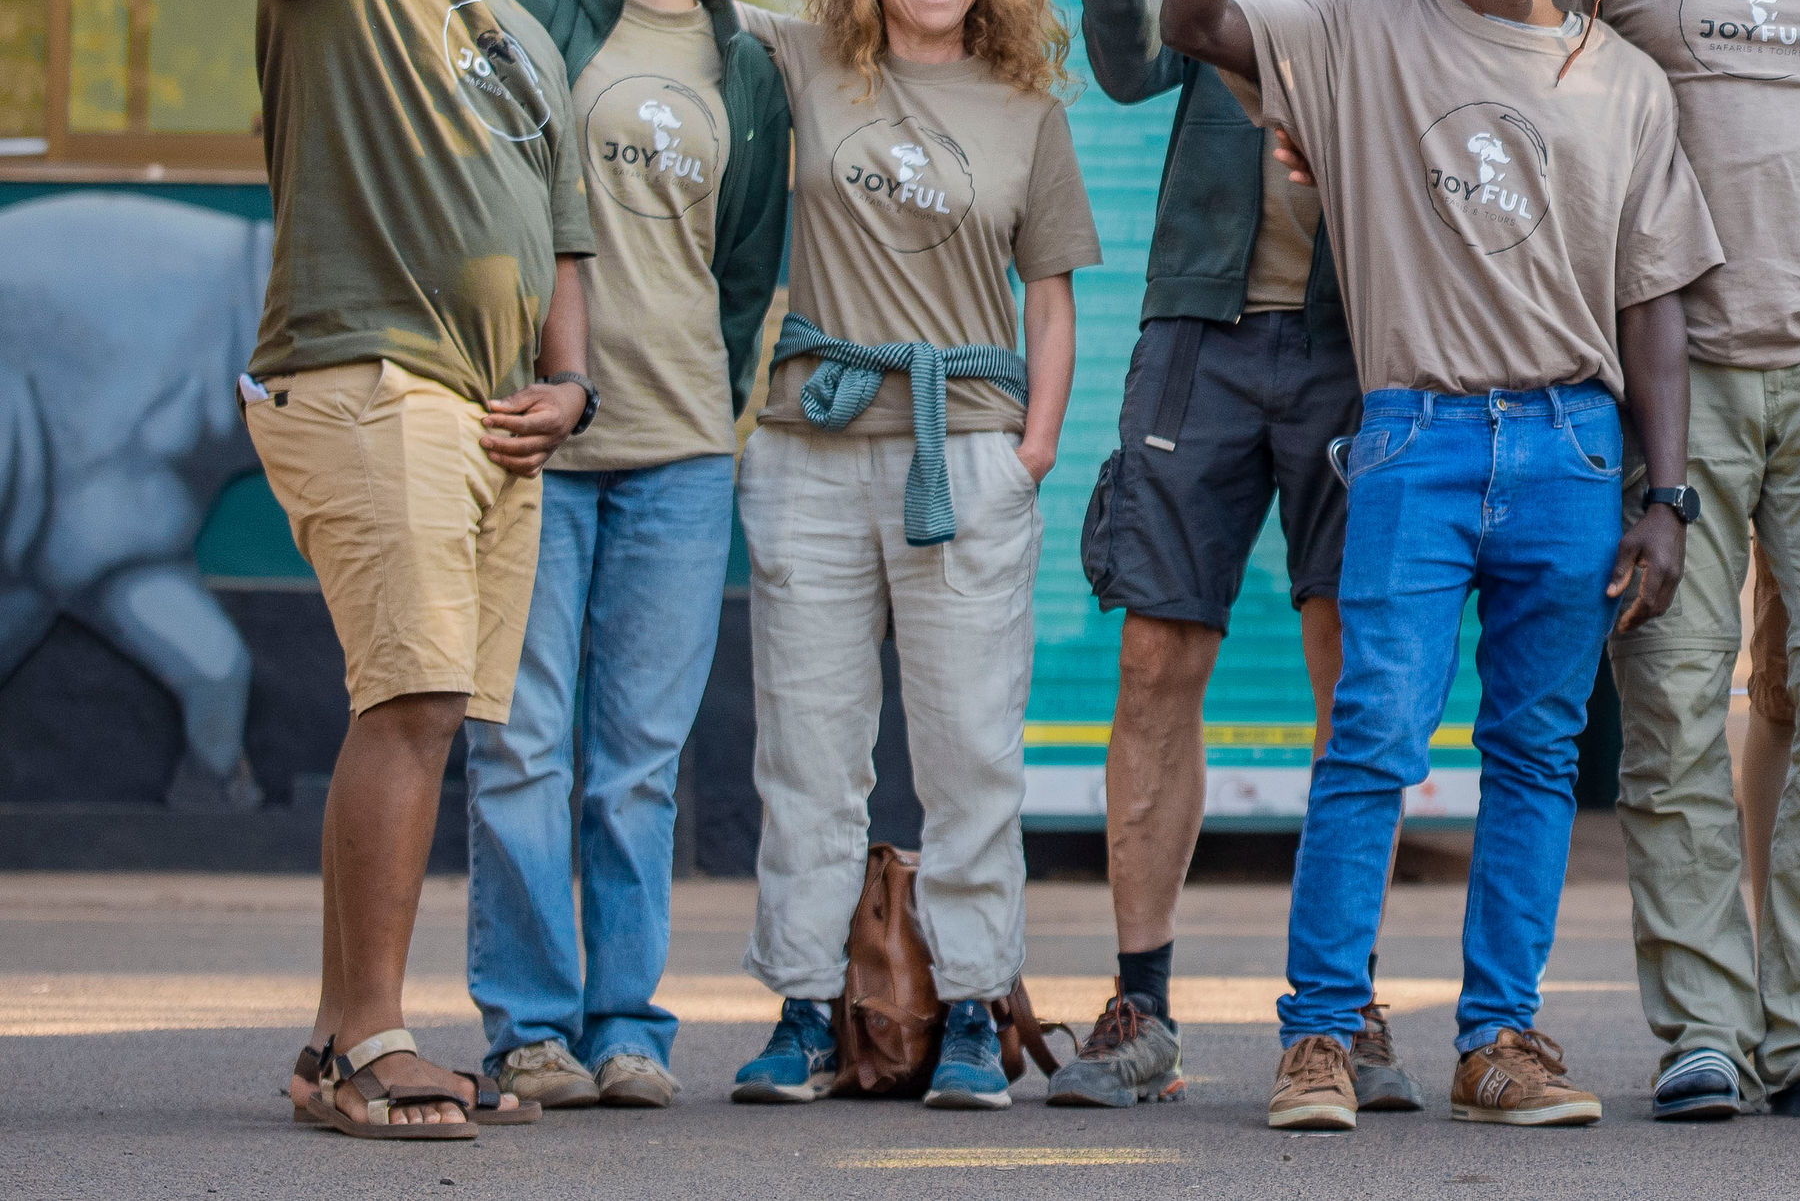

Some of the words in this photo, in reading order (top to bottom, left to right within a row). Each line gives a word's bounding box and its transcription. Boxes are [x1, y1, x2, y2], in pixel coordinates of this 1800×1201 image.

[1710, 43, 1752, 53] SAFARIS
[603, 141, 704, 184] JOYFUL
[845, 165, 950, 214] JOYFUL
[1431, 169, 1532, 220] JOYFUL
[1484, 211, 1516, 227] TOURS
